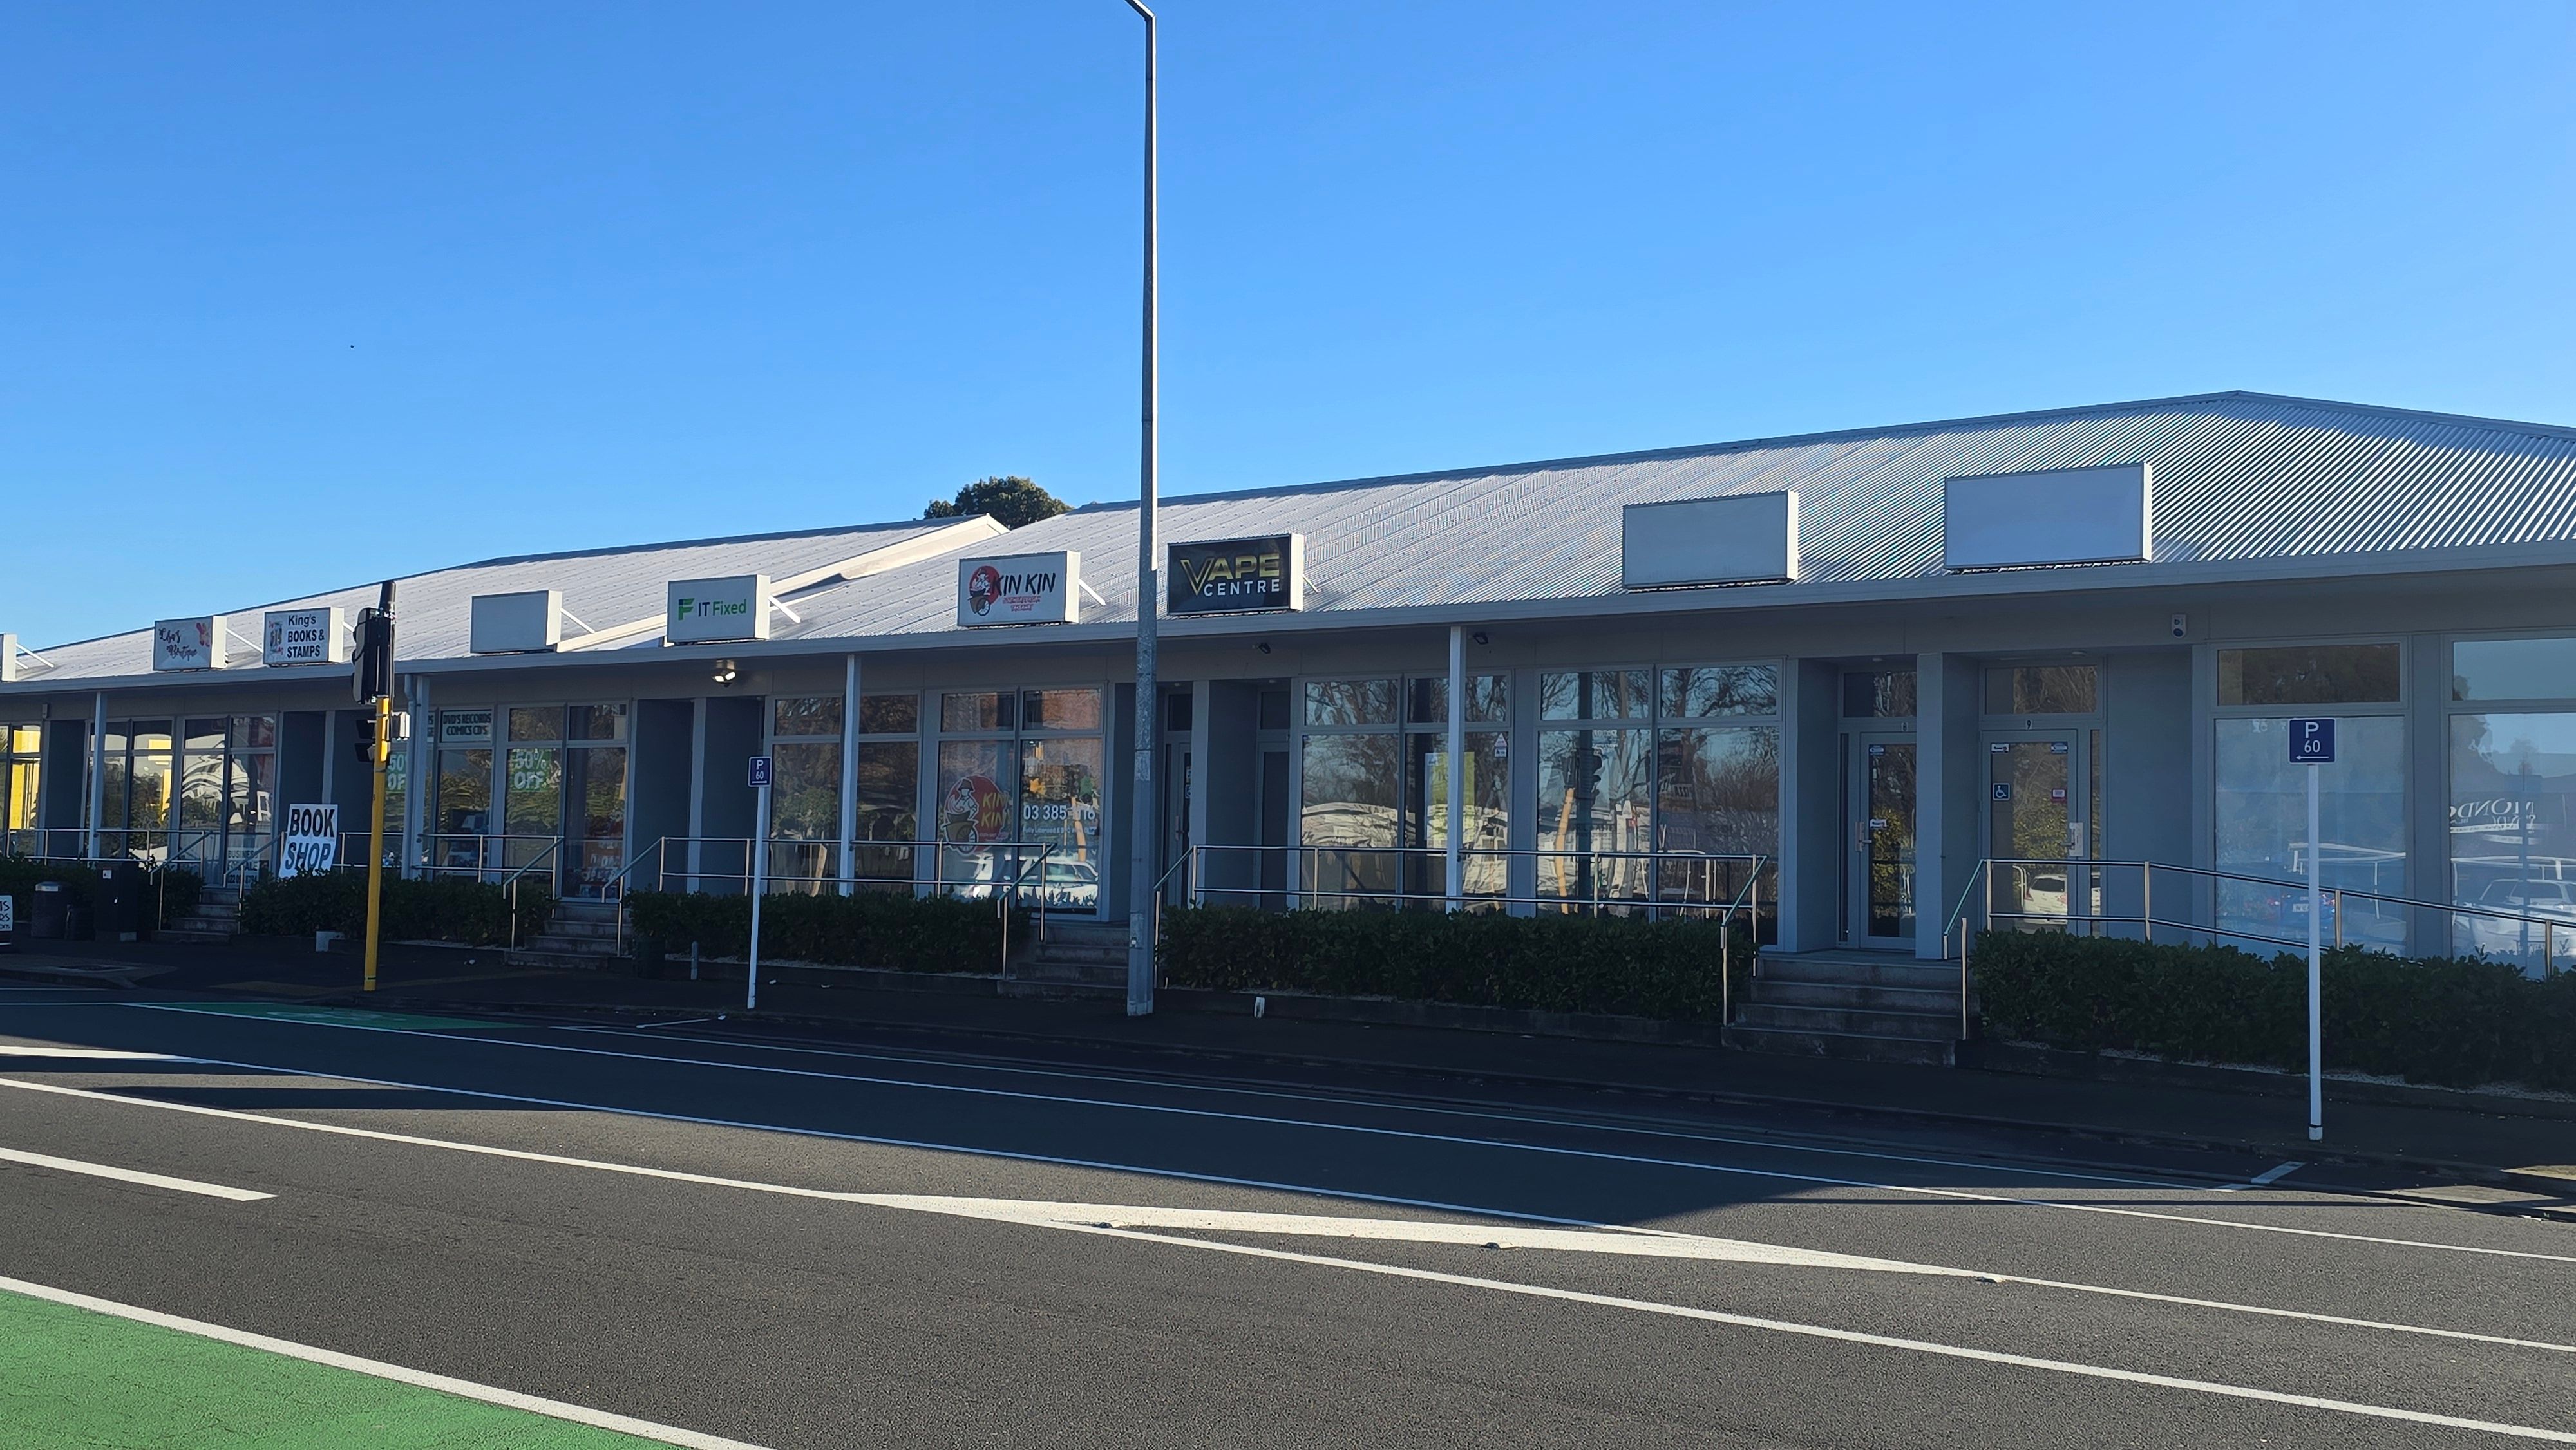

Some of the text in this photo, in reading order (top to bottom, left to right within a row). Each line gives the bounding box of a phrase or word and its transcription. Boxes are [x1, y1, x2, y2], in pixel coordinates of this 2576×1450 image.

[1180, 553, 1280, 596] VAPE
[993, 572, 1056, 596] KIN KIN
[1204, 579, 1280, 597] CENTRE
[698, 601, 710, 617] IT
[712, 599, 746, 616] Fixed
[288, 613, 317, 628] King's
[287, 628, 325, 643] BOOKS &
[287, 645, 321, 659] STAMPS
[462, 713, 491, 724] RECORDS
[2027, 720, 2031, 730] 9
[2305, 721, 2320, 739] P
[2304, 740, 2320, 753] 60
[516, 751, 547, 769] 50%
[756, 759, 764, 770] P
[514, 771, 545, 789] OFF
[755, 771, 764, 780] 60
[983, 792, 1009, 809] KIN
[981, 811, 1007, 828] KIN
[1023, 805, 1039, 820] 03
[1043, 805, 1067, 820] 385
[289, 808, 335, 837] BOOK
[285, 842, 331, 869] SHOP
